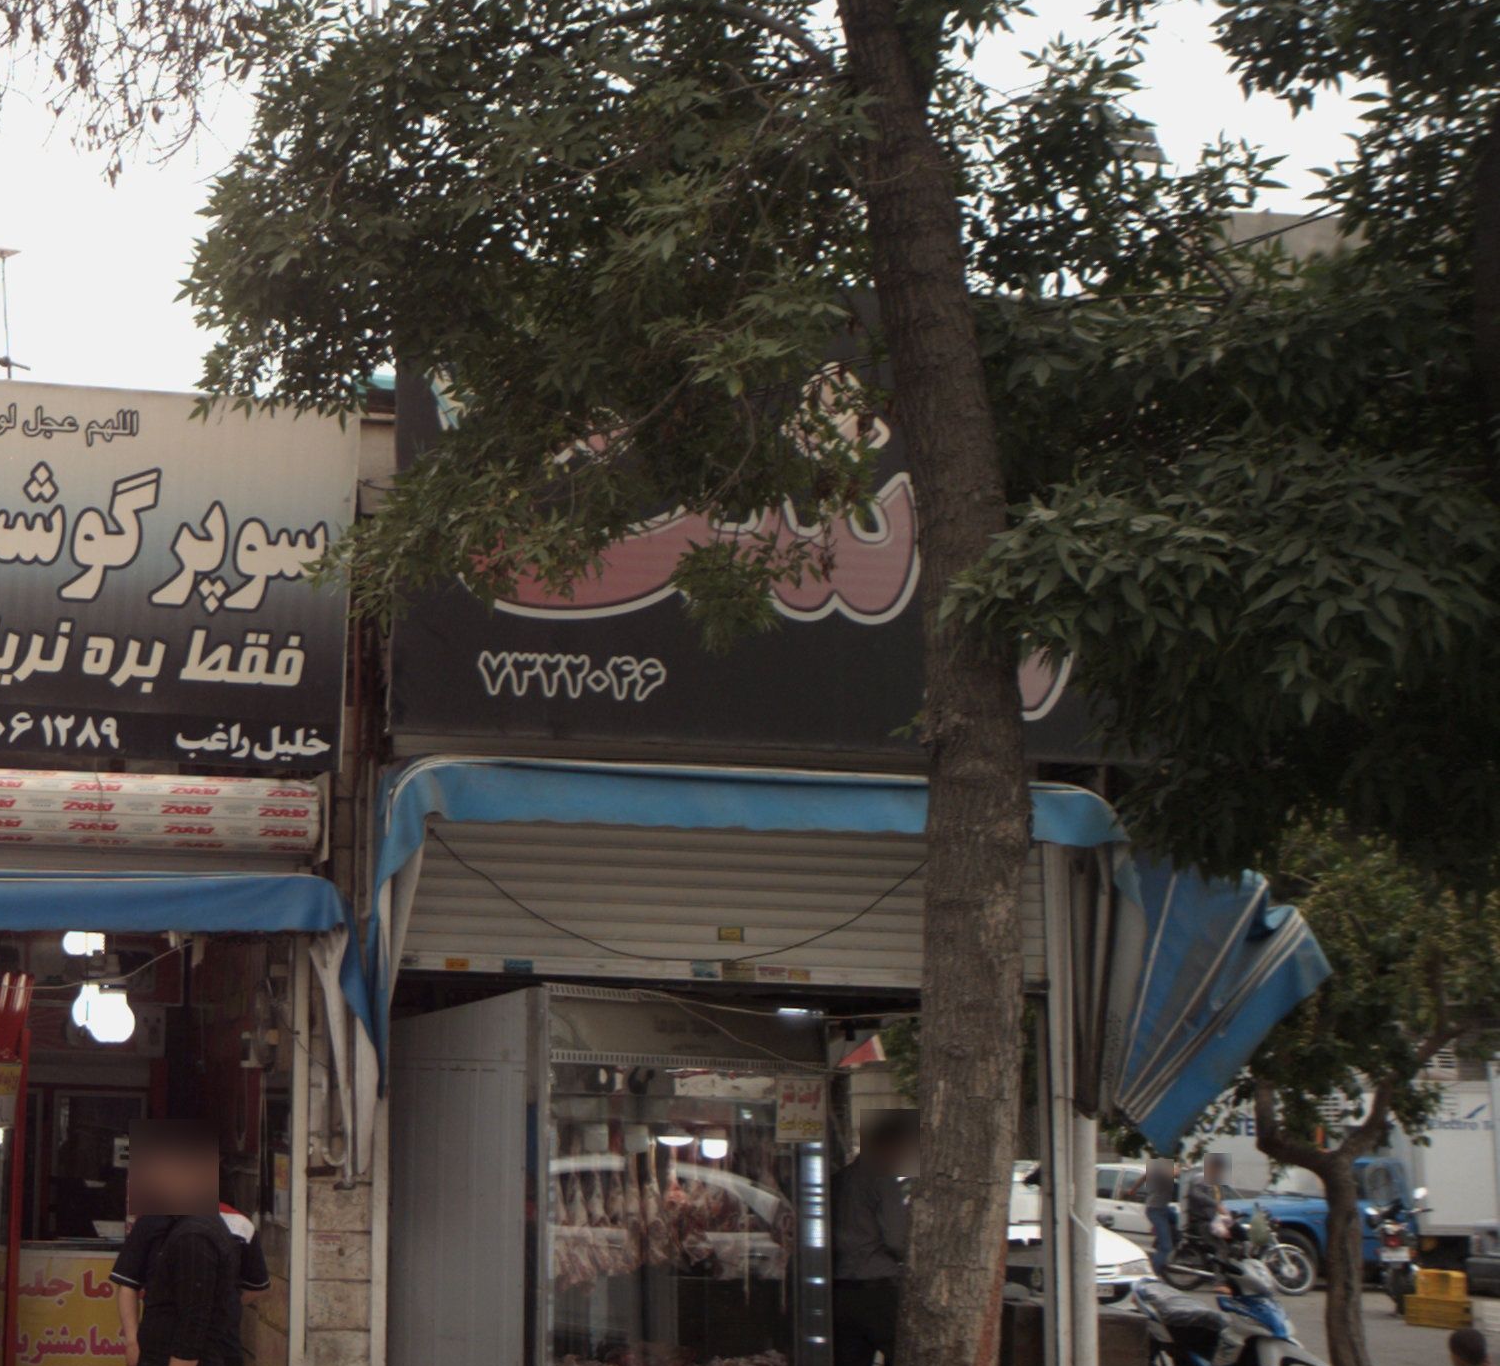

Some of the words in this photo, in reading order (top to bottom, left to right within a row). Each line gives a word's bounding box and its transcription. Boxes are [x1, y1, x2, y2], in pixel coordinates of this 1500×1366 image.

[22, 405, 79, 439] عجل
[85, 409, 139, 447] اللهم
[148, 500, 329, 614] سوپر
[80, 630, 167, 694] بره
[178, 628, 307, 688] فقط
[175, 722, 250, 759] راغب
[252, 726, 332, 762] خلیل
[82, 1269, 114, 1299] ما
